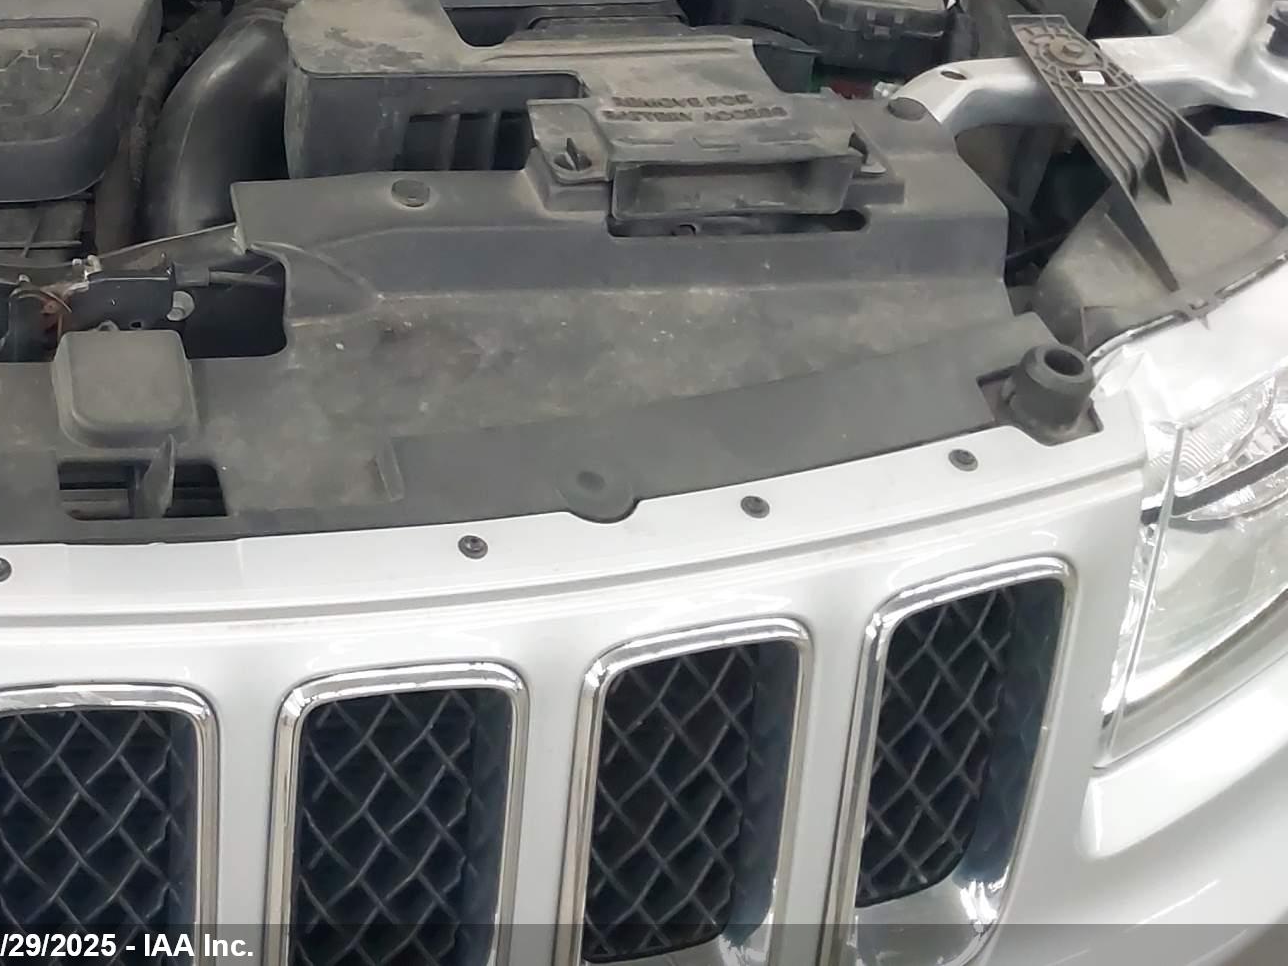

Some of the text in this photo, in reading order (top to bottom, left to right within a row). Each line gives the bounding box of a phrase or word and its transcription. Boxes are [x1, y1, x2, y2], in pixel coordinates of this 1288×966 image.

[612, 94, 753, 108] REMOVE FOR
[602, 106, 787, 122] BATTERY ACCESS
